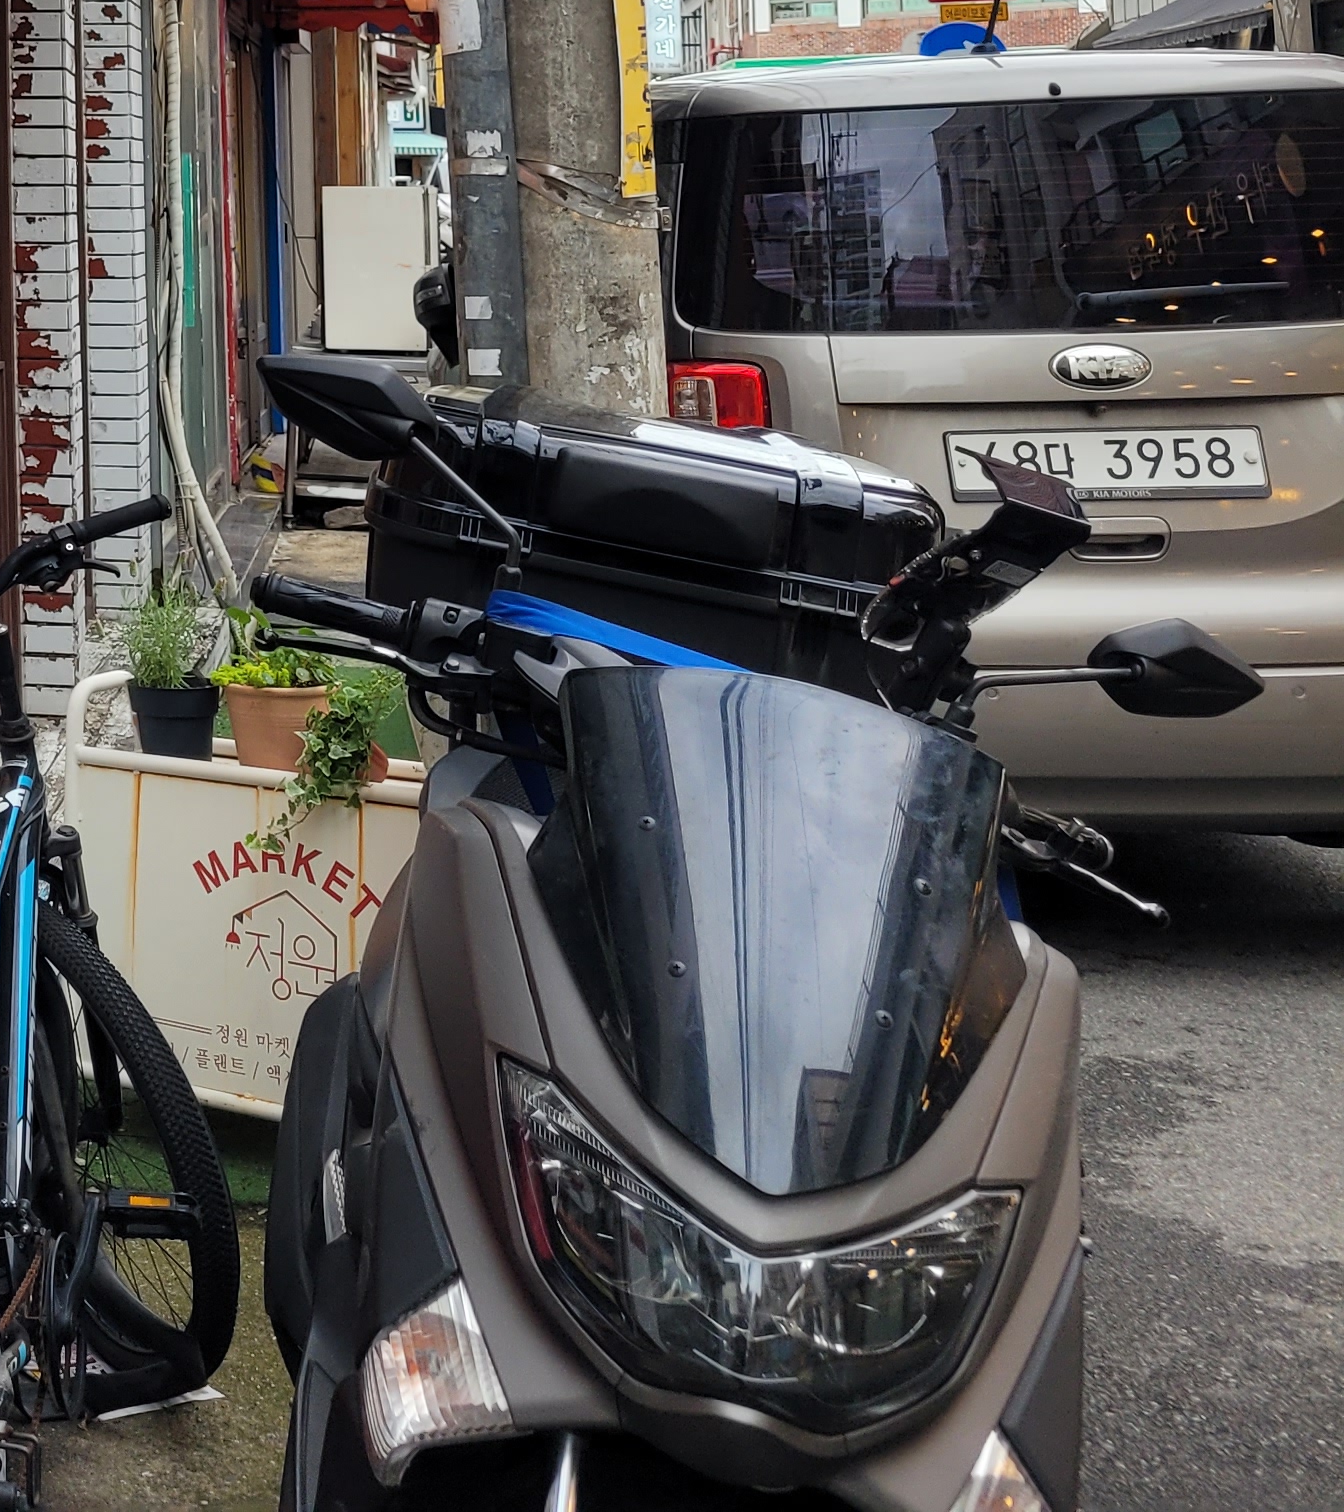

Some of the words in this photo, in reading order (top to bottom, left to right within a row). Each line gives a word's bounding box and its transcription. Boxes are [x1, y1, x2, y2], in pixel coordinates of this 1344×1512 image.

[1103, 436, 1236, 480] 3958
[192, 839, 382, 919] MARKET
[215, 1023, 249, 1049] 정원
[255, 1031, 291, 1060] 마켓
